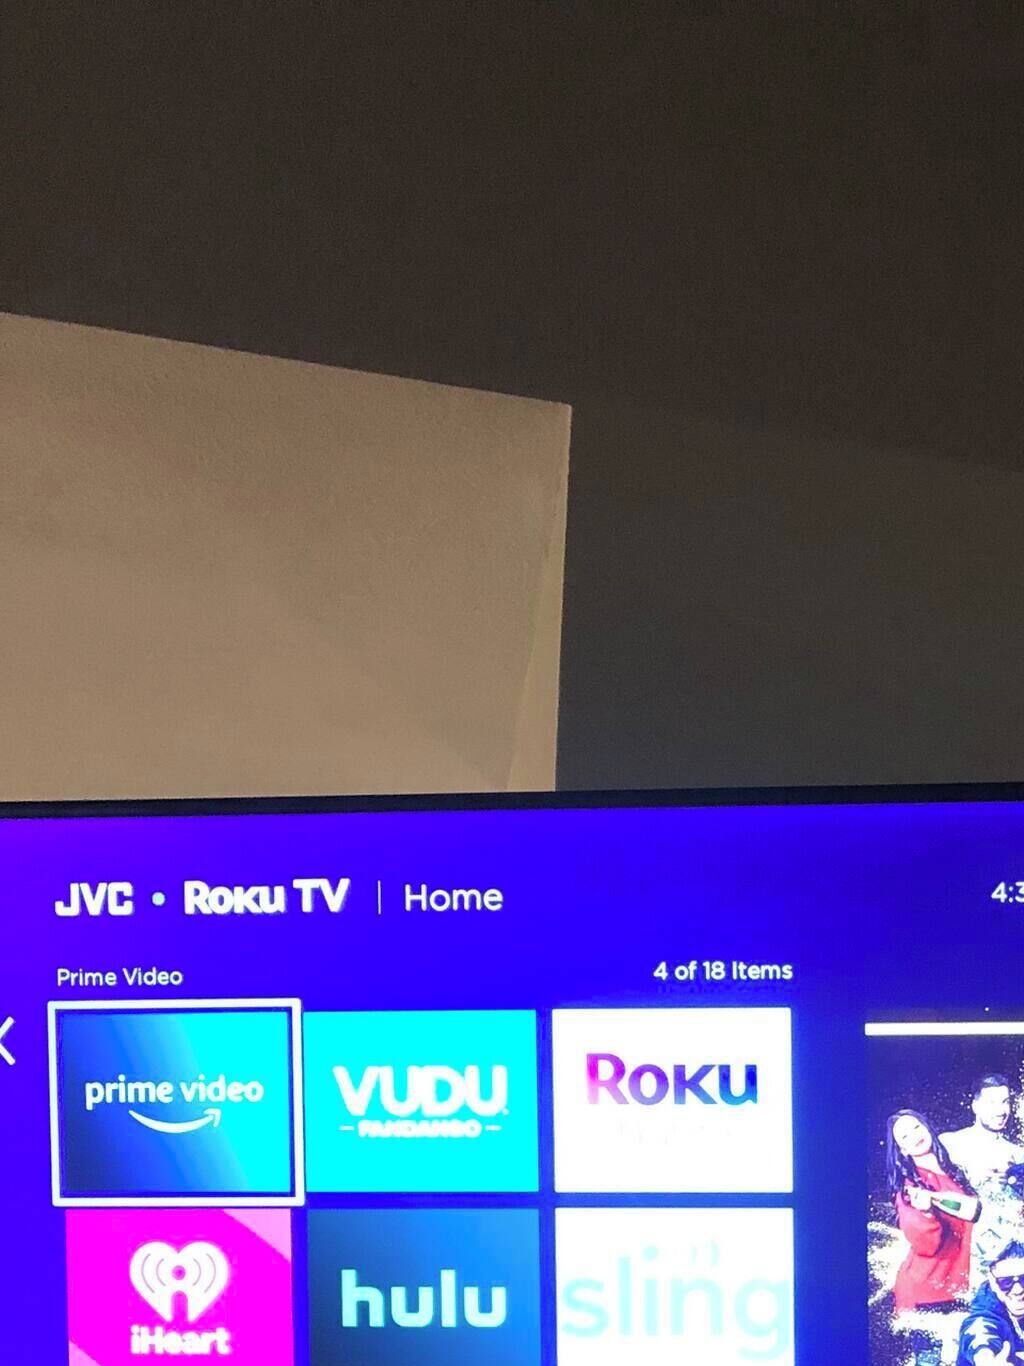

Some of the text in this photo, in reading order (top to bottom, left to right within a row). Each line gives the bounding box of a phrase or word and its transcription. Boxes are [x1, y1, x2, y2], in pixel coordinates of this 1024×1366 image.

[55, 878, 351, 917] JVC Roku TV
[404, 884, 504, 912] Home
[57, 967, 183, 987] Prime Video
[653, 961, 793, 980] 4 of 18 Items
[85, 1074, 264, 1110] prime video
[332, 1065, 508, 1117] VUDU
[585, 1052, 758, 1106] Roku
[341, 1268, 508, 1328] hulu
[561, 1244, 792, 1361] sling
[130, 1324, 232, 1355] iHeart
